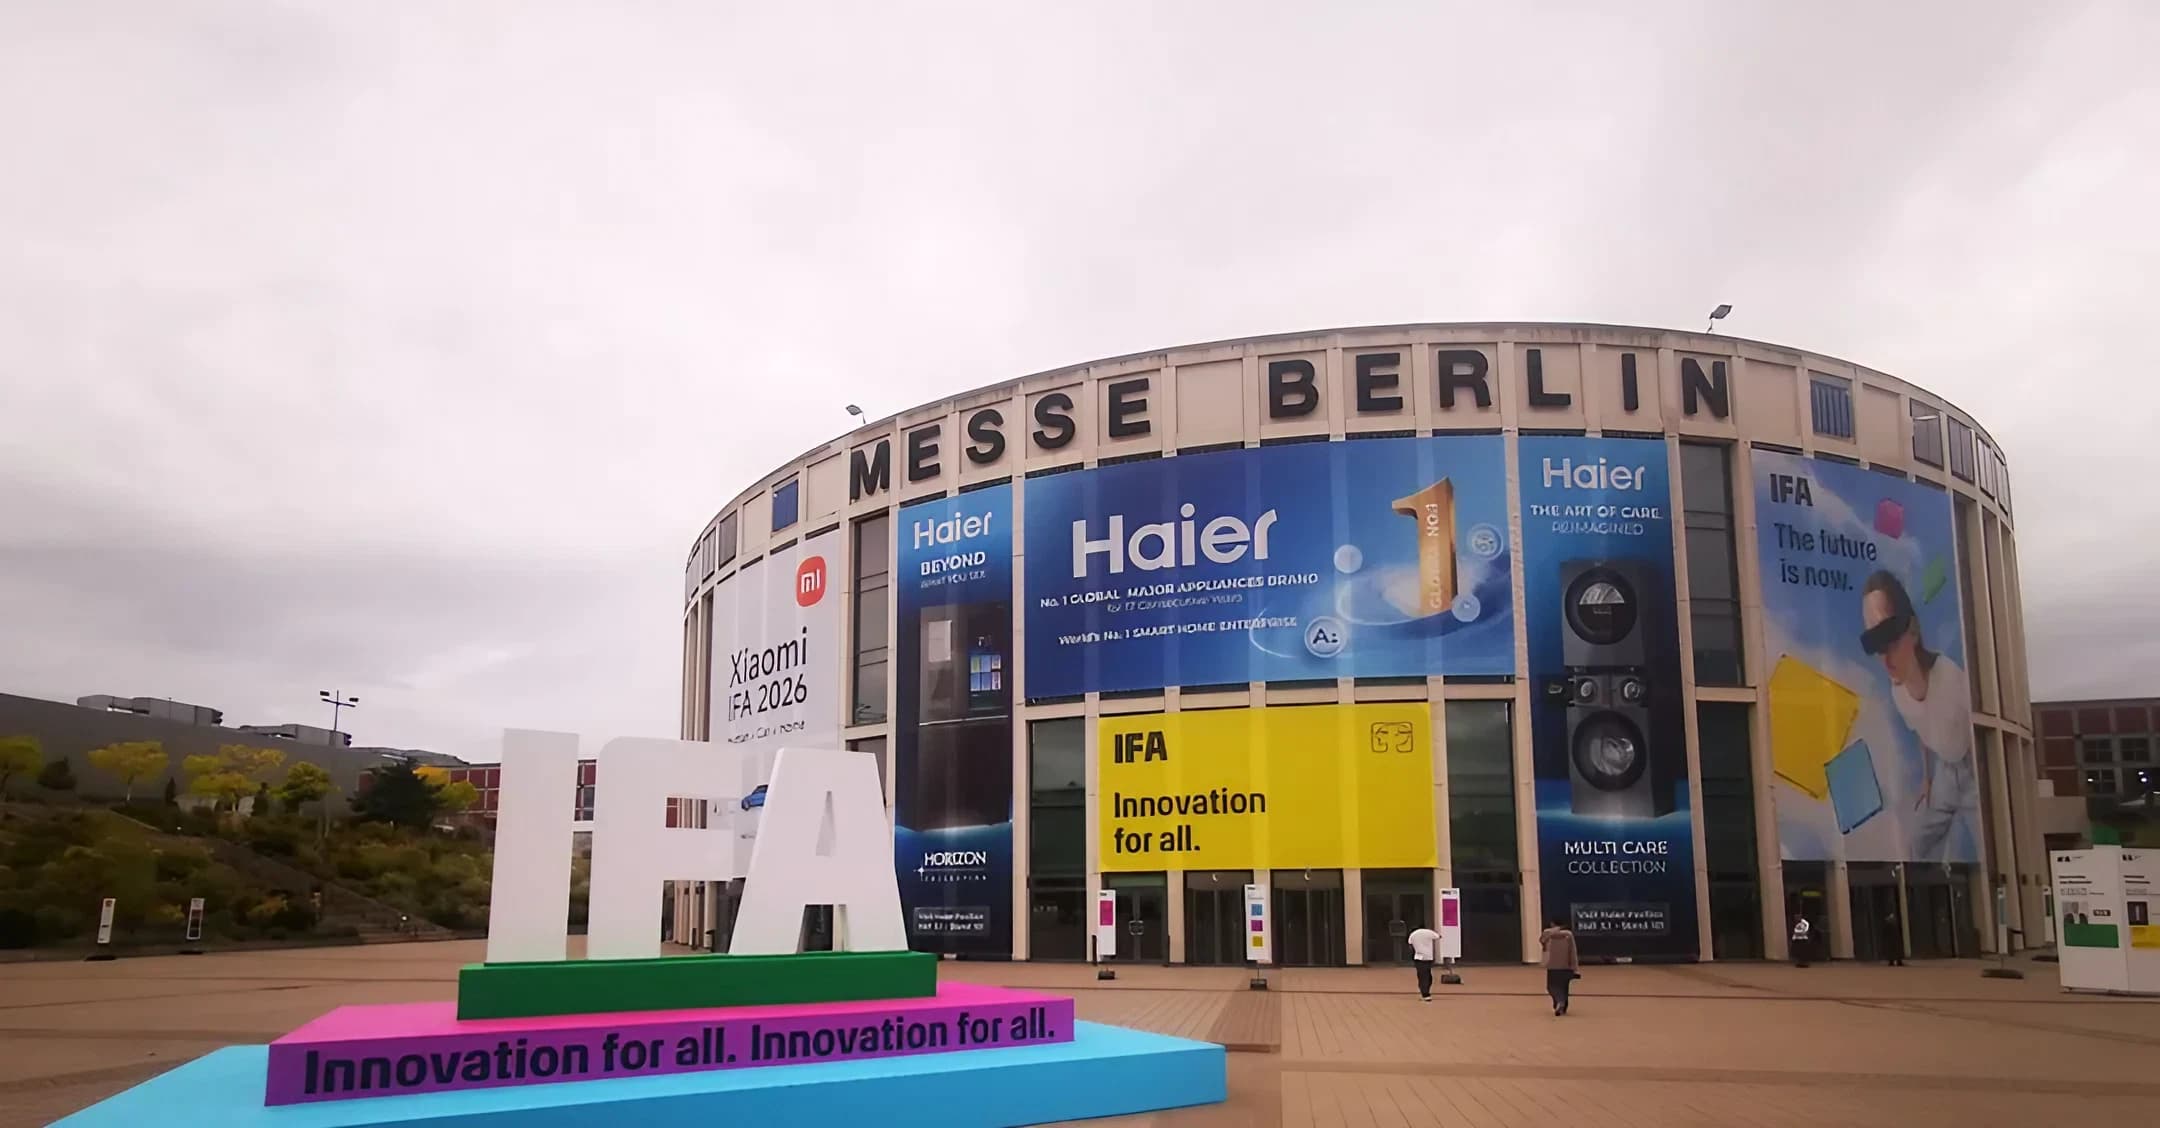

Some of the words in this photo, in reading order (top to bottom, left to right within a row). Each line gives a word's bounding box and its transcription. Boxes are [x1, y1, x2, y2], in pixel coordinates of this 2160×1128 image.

[849, 379, 1151, 501] MESSE
[1269, 349, 1729, 417] BERLIN
[1543, 457, 1646, 491] Haier
[1770, 473, 1813, 506] IFA
[1530, 504, 1560, 516] THE
[914, 511, 992, 549] Haier
[1073, 503, 1277, 578] Haier
[1773, 523, 1814, 551] The
[1820, 529, 1877, 561] future
[1780, 558, 1799, 584] is
[1805, 566, 1853, 591] now.
[730, 626, 807, 688] Xiaomi
[728, 690, 752, 722] IFA
[757, 673, 807, 713] 2026
[1114, 731, 1168, 763] IFA
[1114, 787, 1266, 818] Innovation
[487, 728, 909, 964] IFA
[1114, 827, 1153, 853] for
[1160, 825, 1200, 851] all.
[1565, 841, 1617, 855] MULTI
[1622, 841, 1668, 855] CARE
[1568, 860, 1666, 874] COLLECTION
[304, 1038, 589, 1095] Innovation
[602, 1033, 664, 1072] for
[675, 1026, 737, 1067] all.
[751, 1016, 947, 1061] Innovation
[957, 1012, 1003, 1045] for
[1010, 1006, 1055, 1041] all.
